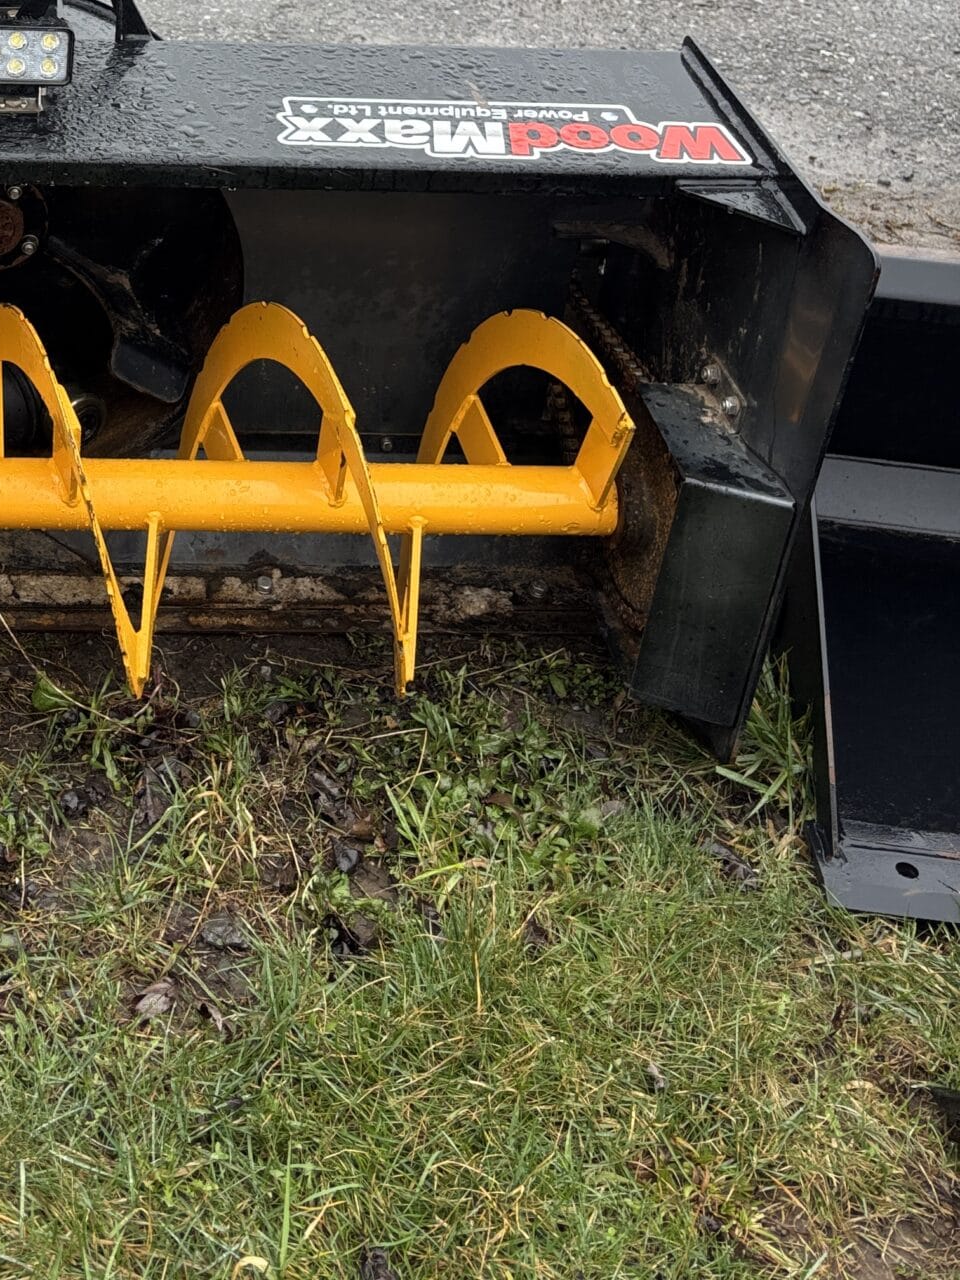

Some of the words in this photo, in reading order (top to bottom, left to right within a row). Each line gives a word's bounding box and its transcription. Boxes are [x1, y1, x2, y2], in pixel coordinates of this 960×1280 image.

[327, 104, 371, 116] Ltd.
[378, 104, 508, 121] Equipment
[513, 108, 589, 121] Power
[286, 115, 747, 162] WoodMaxx
